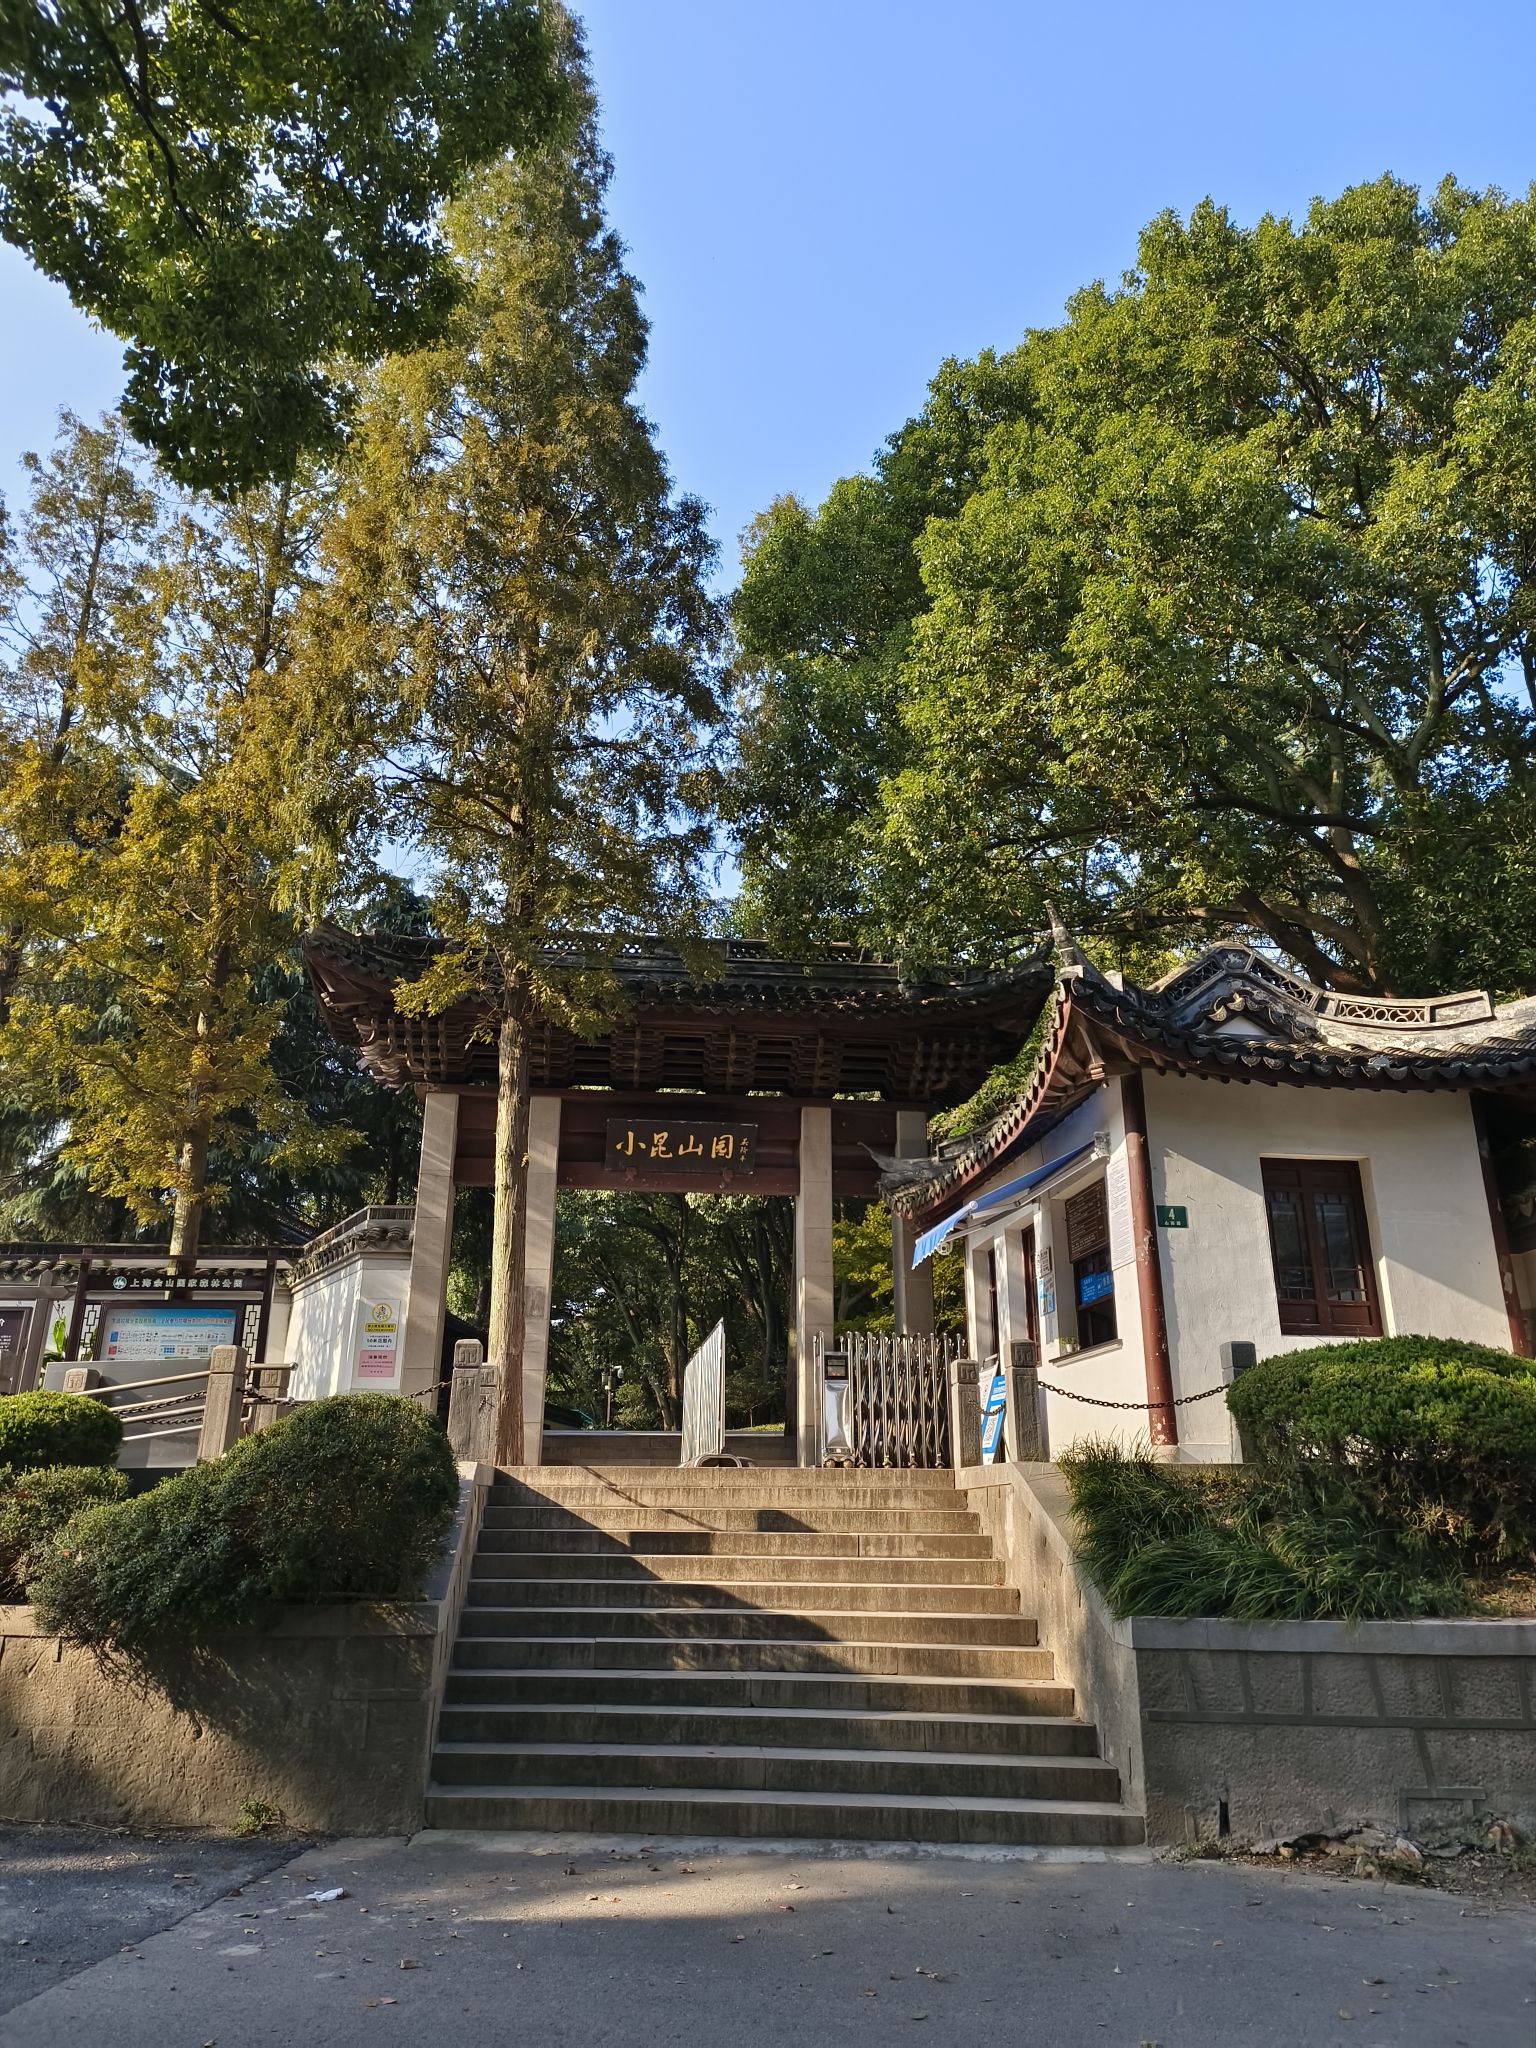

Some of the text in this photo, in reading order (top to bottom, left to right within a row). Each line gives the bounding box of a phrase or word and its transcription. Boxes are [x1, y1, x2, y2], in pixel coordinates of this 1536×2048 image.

[615, 1130, 734, 1160] 小昆山园
[1168, 1208, 1175, 1220] 4
